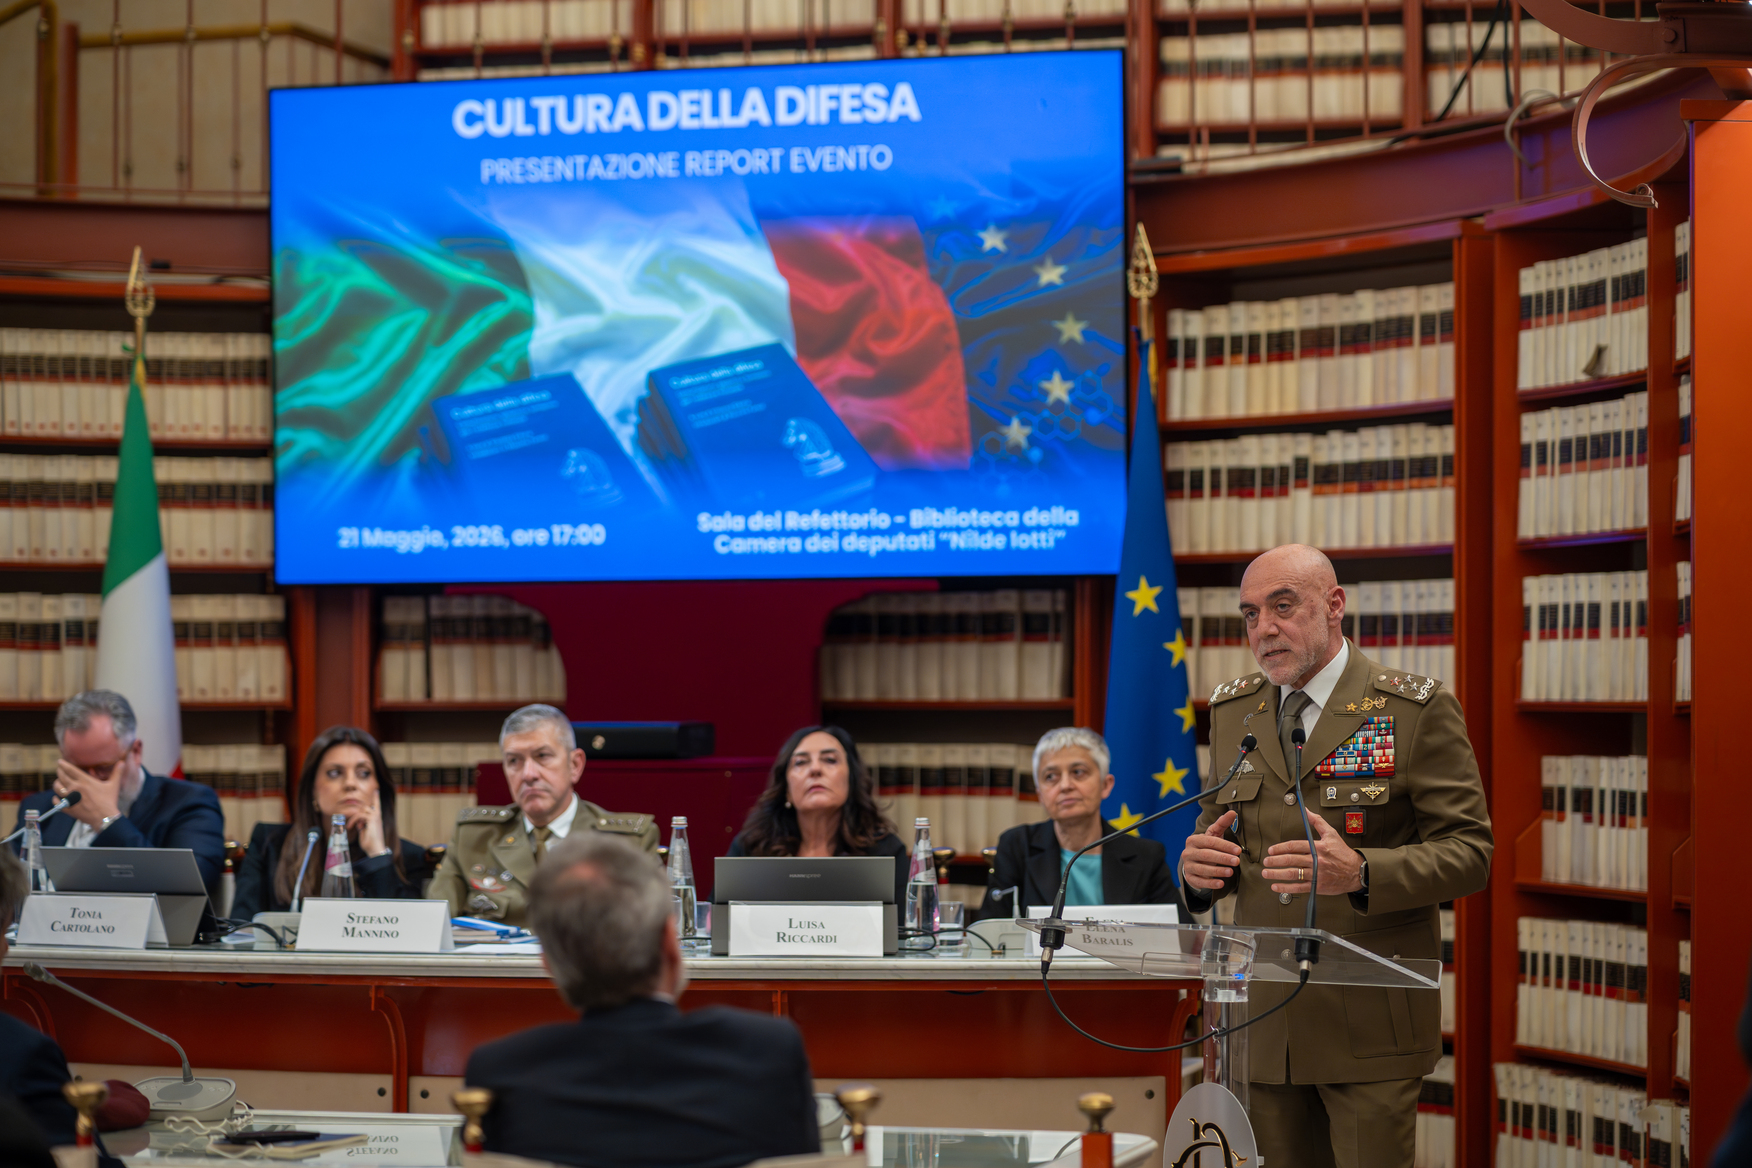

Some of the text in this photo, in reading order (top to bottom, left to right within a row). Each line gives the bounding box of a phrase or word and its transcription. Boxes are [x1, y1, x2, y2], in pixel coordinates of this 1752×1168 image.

[452, 82, 922, 139] CULTURA DELLA DIFESA
[480, 144, 893, 185] PRESENTAZIONE REPORT EVENTO
[697, 510, 746, 533] Sala
[747, 510, 782, 531] del
[784, 508, 891, 531] Refettorio
[909, 506, 1020, 529] Biblioteca
[1022, 505, 1079, 527] della
[337, 526, 359, 548] 21
[361, 524, 449, 554] Maggio,
[511, 528, 550, 547] ore
[551, 523, 606, 546] 17:00
[713, 534, 802, 554] Camera
[804, 530, 839, 553] dei
[841, 529, 935, 557] deputati
